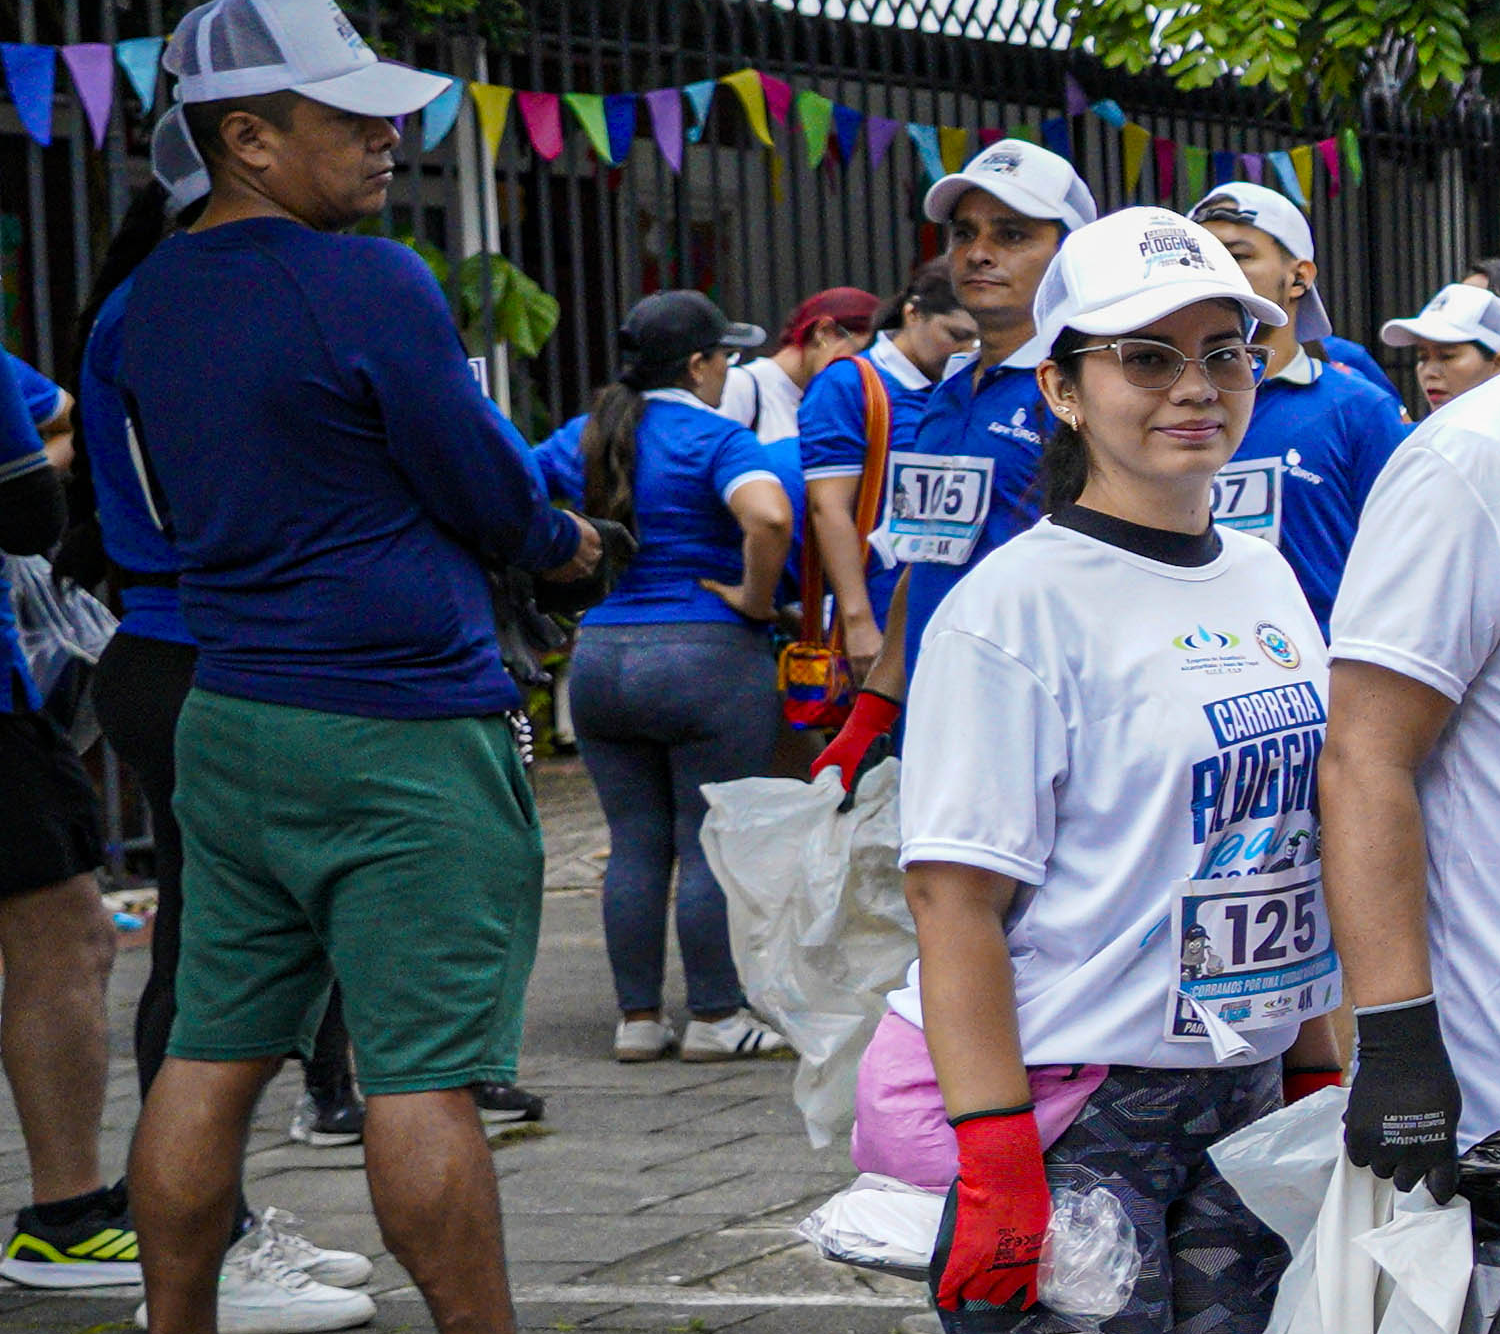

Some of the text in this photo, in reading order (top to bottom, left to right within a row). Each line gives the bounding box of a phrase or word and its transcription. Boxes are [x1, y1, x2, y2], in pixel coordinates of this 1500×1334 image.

[1211, 478, 1248, 514] 7
[1213, 684, 1321, 742] CARRRERA
[1191, 727, 1327, 844] PLOGGI
[1225, 889, 1315, 966] 125
[1298, 984, 1313, 1011] 4K
[1381, 1132, 1448, 1146] TITANIUM
